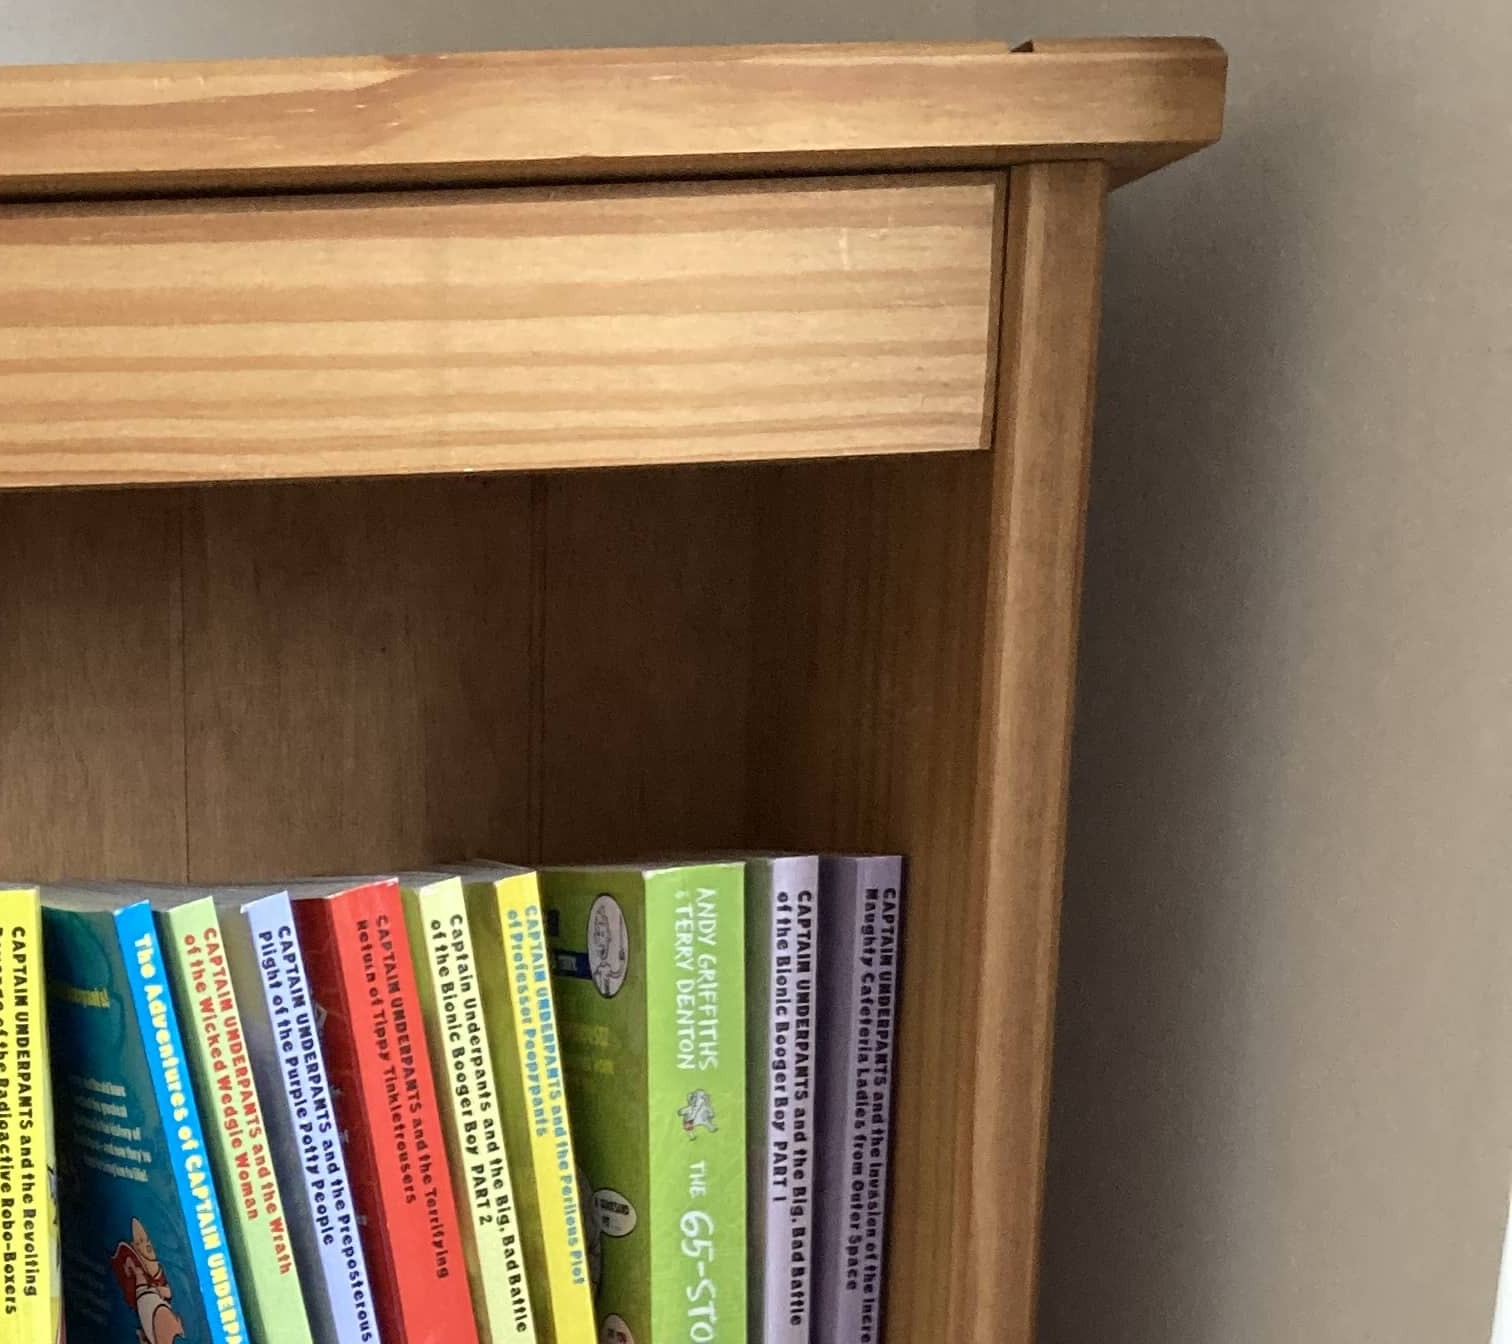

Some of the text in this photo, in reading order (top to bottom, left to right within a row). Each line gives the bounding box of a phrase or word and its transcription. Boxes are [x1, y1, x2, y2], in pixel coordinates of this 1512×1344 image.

[675, 904, 695, 1070] TERRY DENTON
[695, 888, 719, 1071] ANDY GRIFFITHS
[12, 926, 39, 1296] CAPTAIN UNDERPANTS and the Revolting
[258, 932, 335, 1245] Plight of the Purple Potty People
[278, 926, 373, 1342] CAPTAIN UNDERPANTS and the Preposterous
[689, 1161, 706, 1197] THE
[0, 1198, 18, 1314] Robo-Boxers
